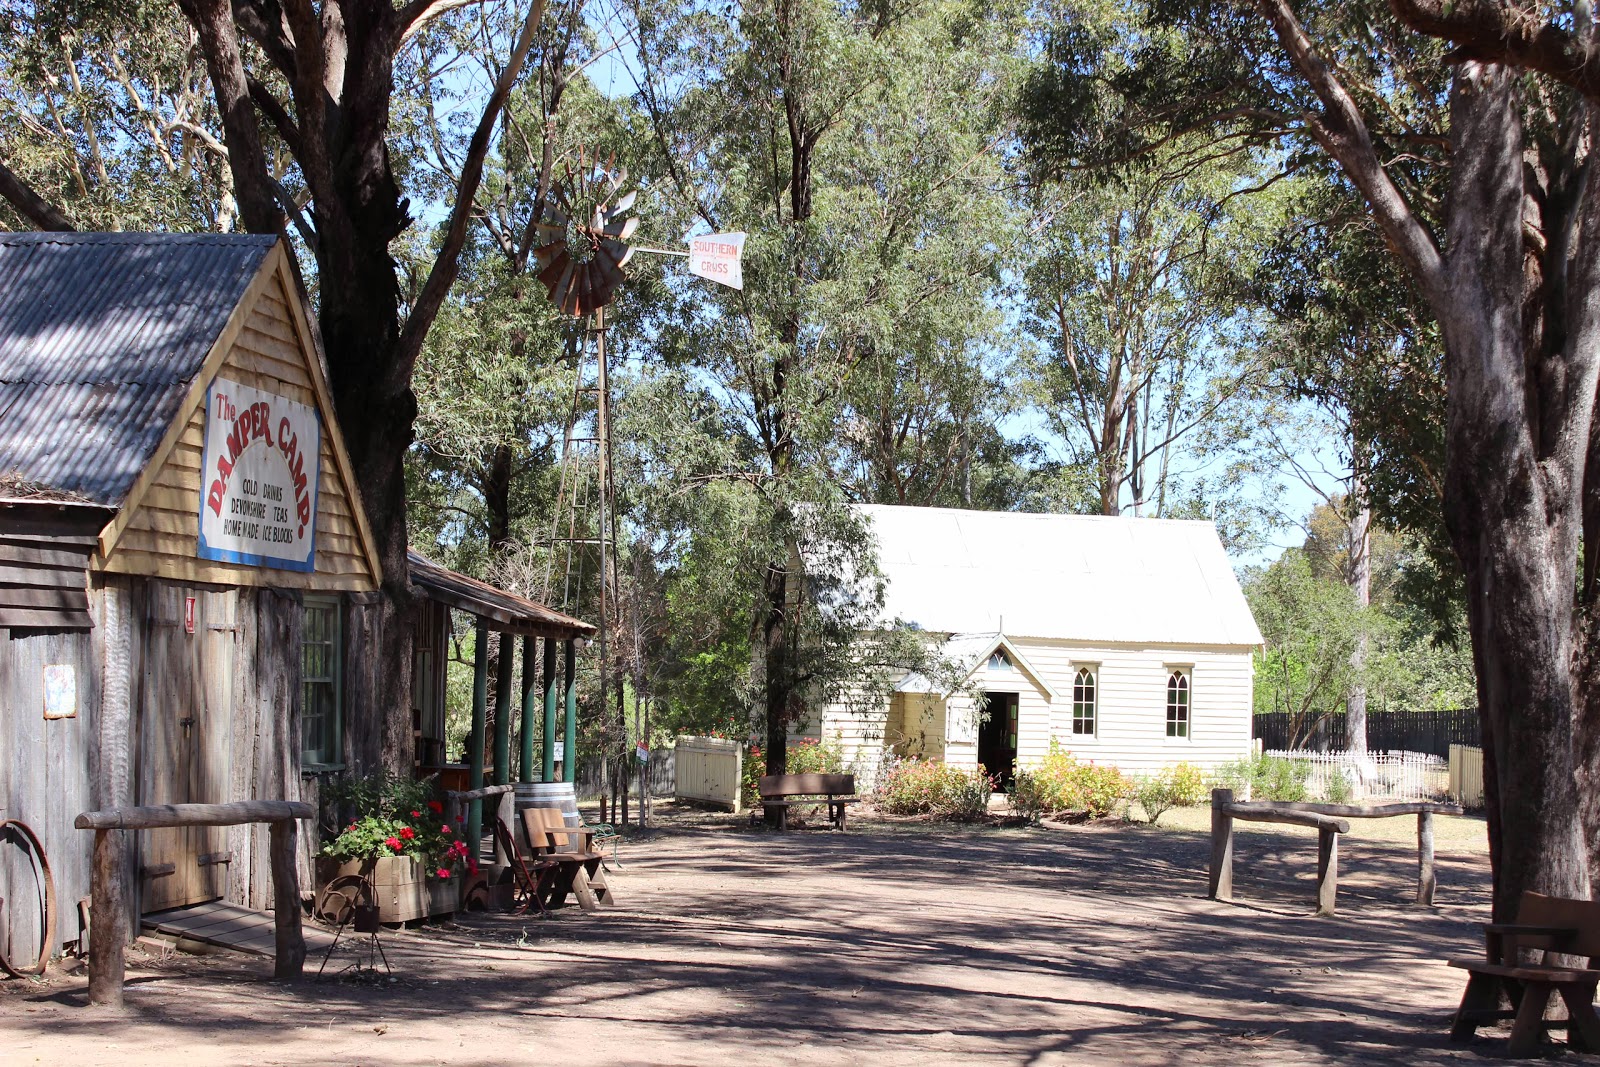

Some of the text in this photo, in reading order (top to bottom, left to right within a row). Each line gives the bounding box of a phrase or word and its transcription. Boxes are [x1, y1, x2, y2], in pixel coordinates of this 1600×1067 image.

[694, 240, 738, 256] SOUTHERN
[701, 261, 729, 274] CROSS
[216, 393, 236, 423] The
[208, 402, 274, 518] DAMPER
[243, 478, 283, 502] COLD DRINKS
[231, 497, 288, 523] DEVONSHIRE TEAS
[223, 518, 293, 544] HOME MADE ICE BLOCKS
